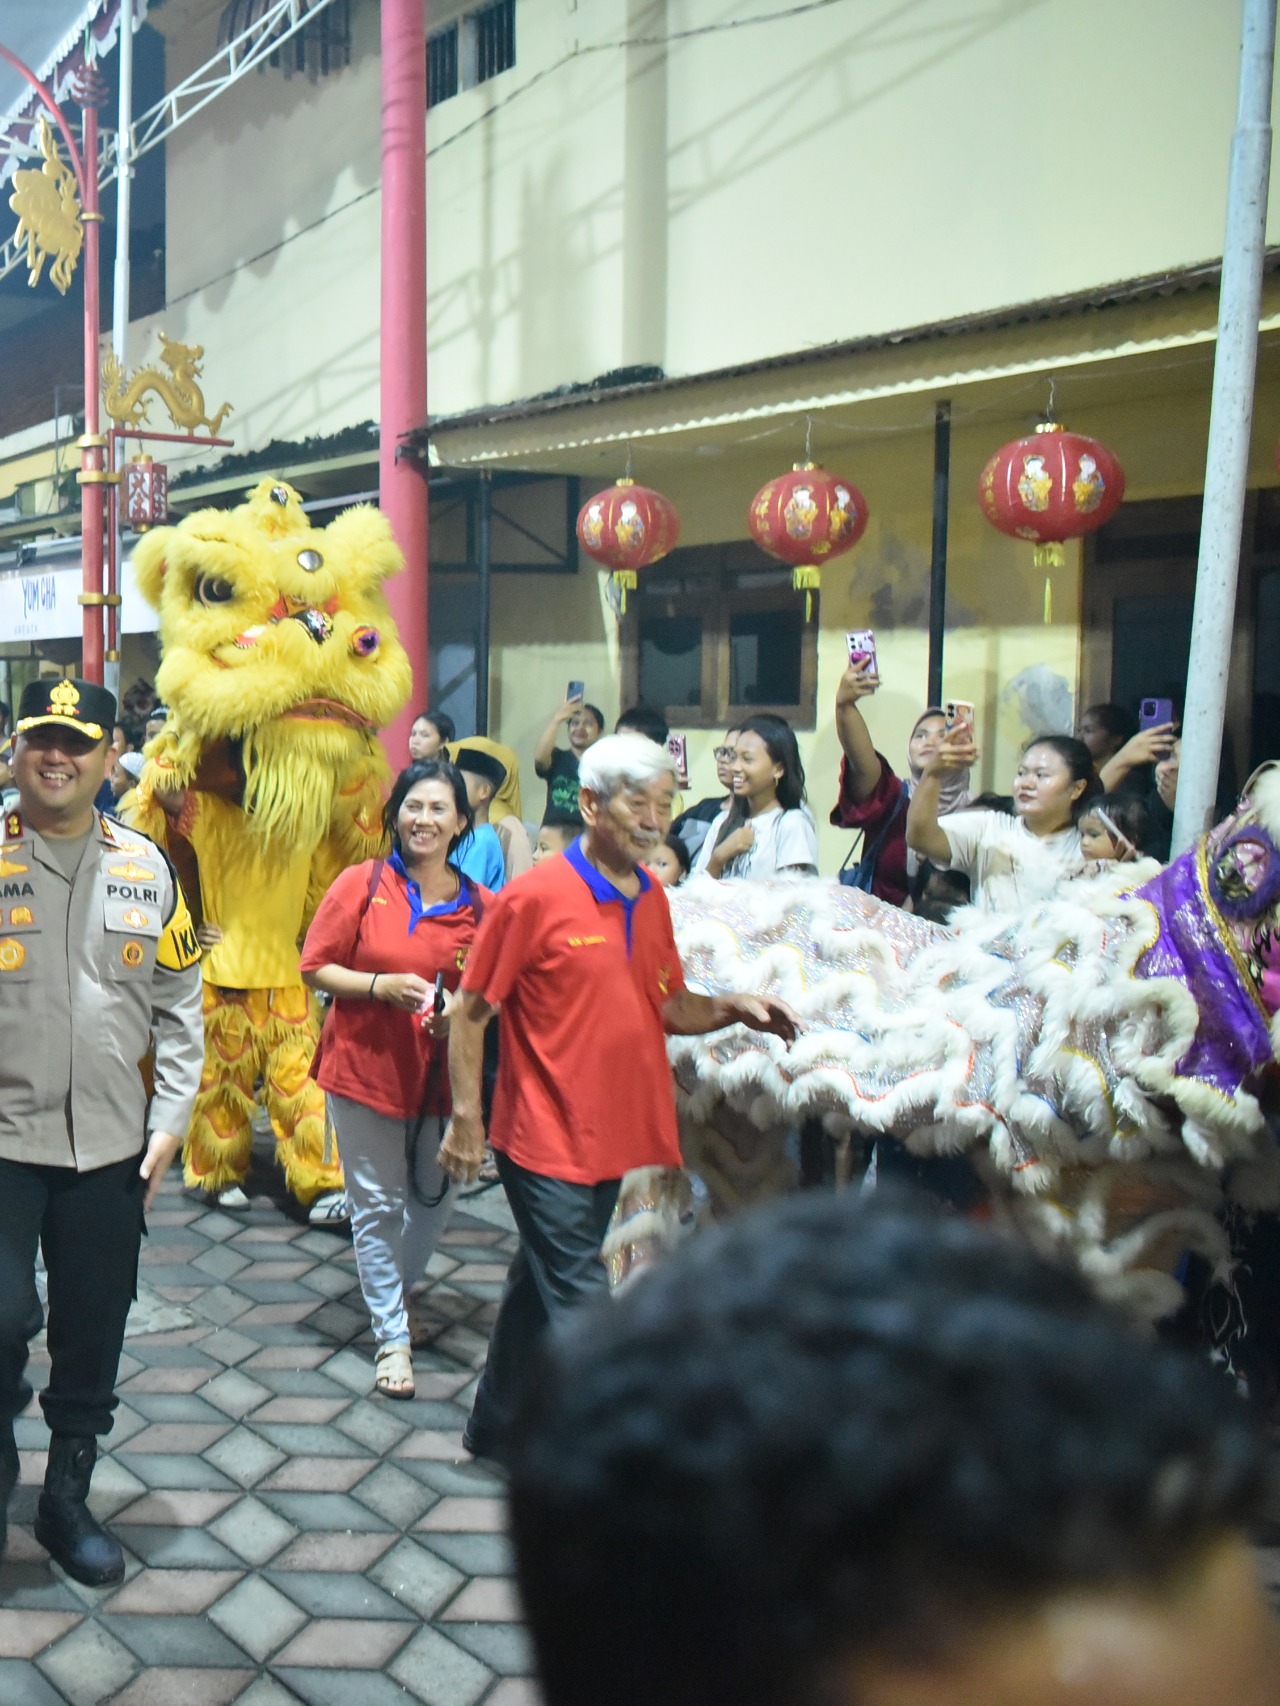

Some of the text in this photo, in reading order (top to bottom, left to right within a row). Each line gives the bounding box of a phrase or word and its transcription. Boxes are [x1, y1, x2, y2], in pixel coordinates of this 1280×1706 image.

[22, 575, 56, 619] YUM CHA
[106, 884, 157, 903] POLRI
